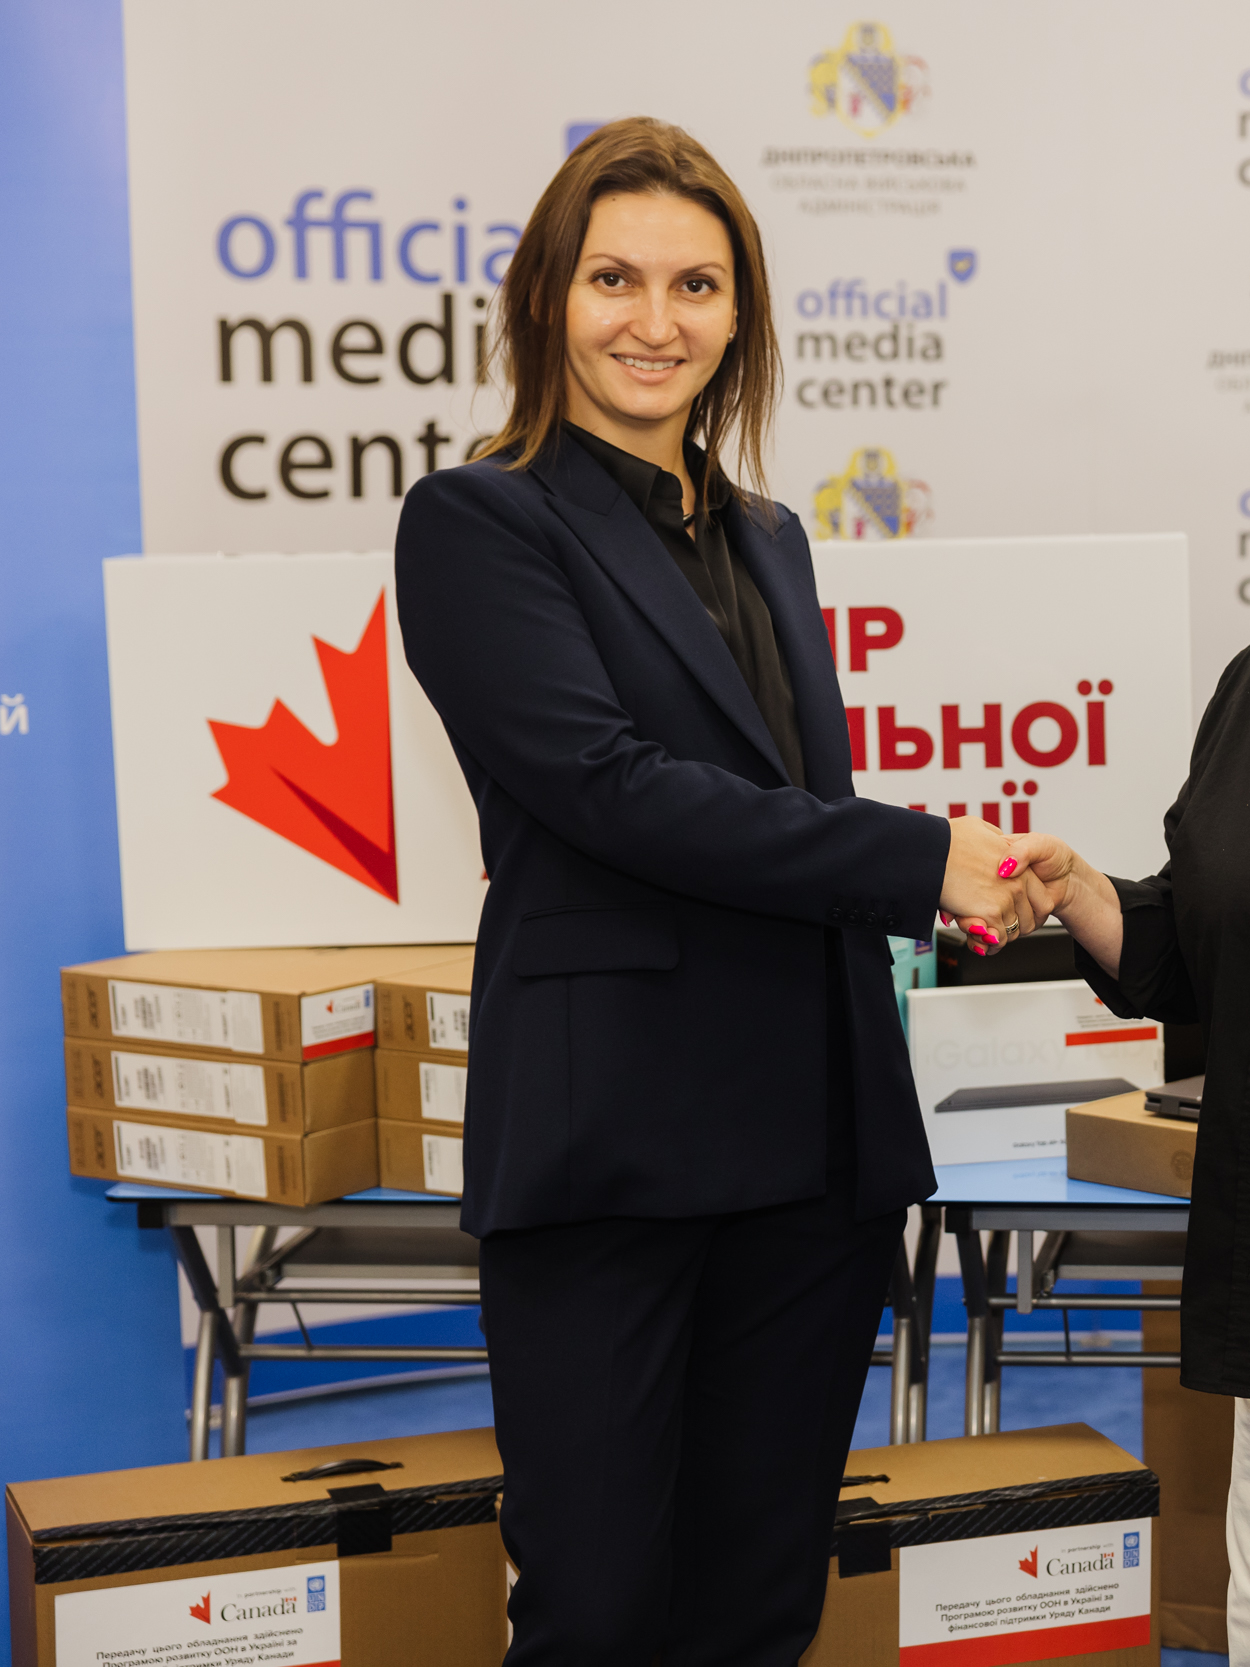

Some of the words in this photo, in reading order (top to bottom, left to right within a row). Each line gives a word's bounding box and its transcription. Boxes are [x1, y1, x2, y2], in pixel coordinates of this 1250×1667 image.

[217, 190, 526, 287] officia
[796, 278, 948, 320] official
[219, 293, 486, 384] medi
[796, 322, 943, 362] media
[796, 374, 948, 409] center
[219, 421, 497, 500] cent
[845, 679, 1114, 771] ЬНОЇ
[1046, 1553, 1114, 1576] Canada
[220, 1597, 296, 1622] Canada
[935, 1601, 980, 1611] Передачу
[985, 1597, 1011, 1605] цього
[1016, 1589, 1070, 1601] обладнання
[1075, 1583, 1119, 1594] здійснено
[941, 1609, 994, 1622] Програмою
[997, 1604, 1037, 1615] розвитку
[1040, 1600, 1061, 1609] ООН
[1071, 1594, 1102, 1604] Україні
[948, 1619, 997, 1633] фінансової
[1000, 1615, 1046, 1625] підтримки
[1049, 1609, 1075, 1619] Уряду
[1078, 1605, 1111, 1614] Канади
[96, 1648, 147, 1660] Передачу
[152, 1643, 182, 1653] цього
[187, 1635, 248, 1649] обладнання
[254, 1628, 303, 1640] здійснено
[165, 1650, 211, 1663] розвитку
[214, 1646, 238, 1656] ООН
[249, 1639, 284, 1651] Україні
[225, 1657, 255, 1665] Уряду
[258, 1652, 294, 1660] Канади
